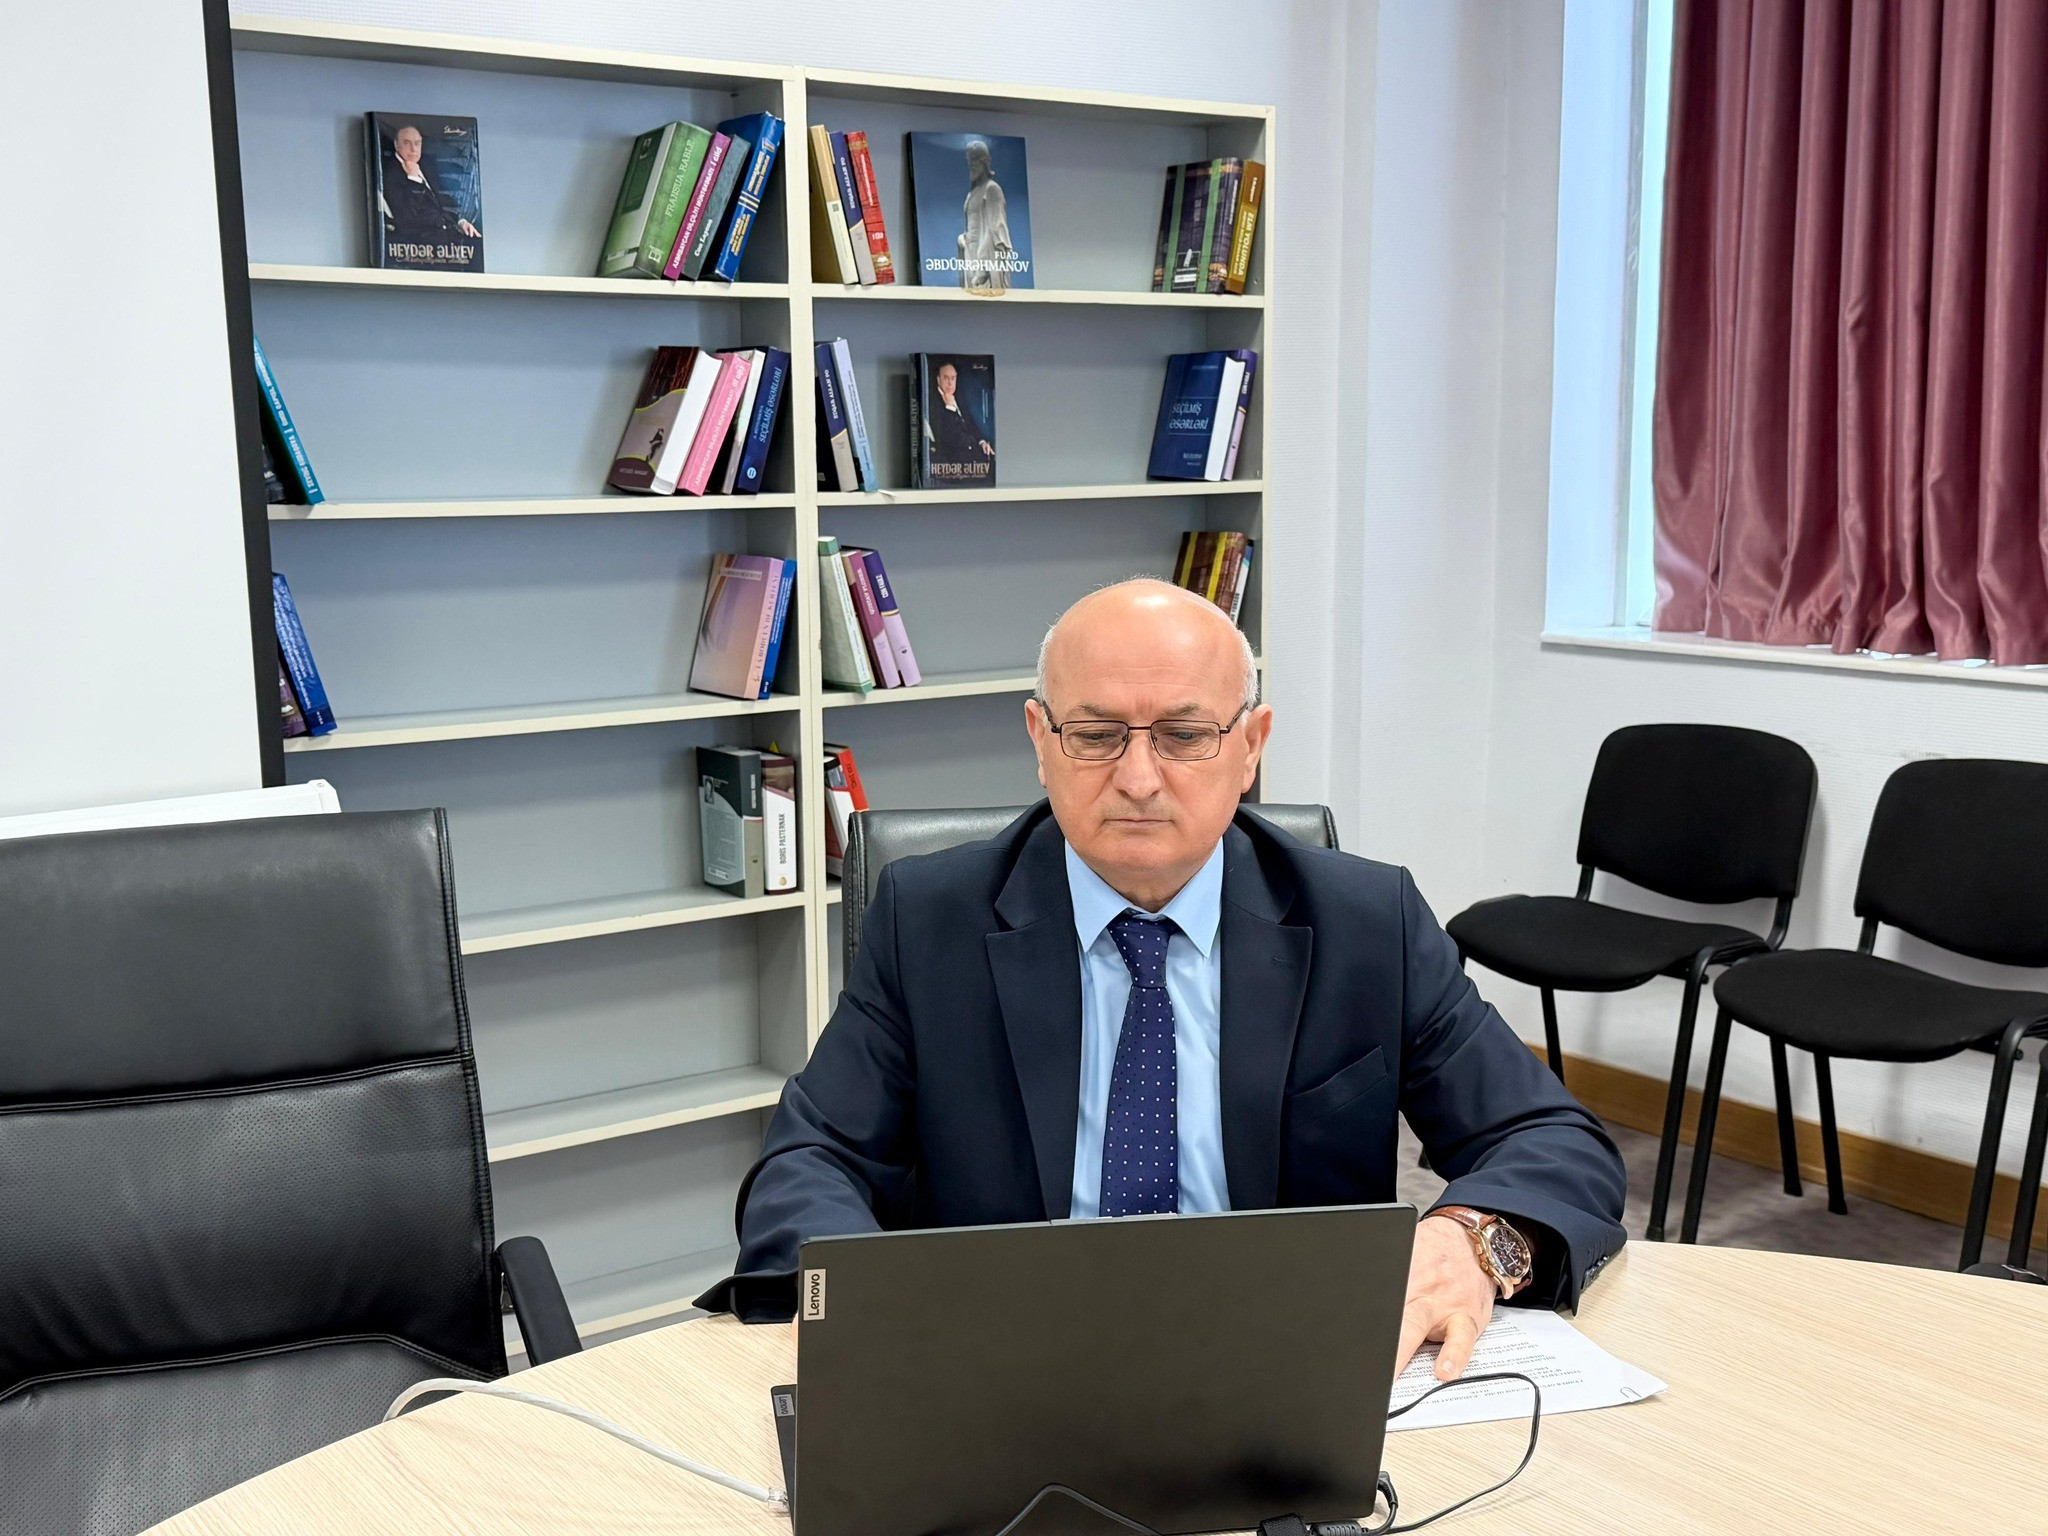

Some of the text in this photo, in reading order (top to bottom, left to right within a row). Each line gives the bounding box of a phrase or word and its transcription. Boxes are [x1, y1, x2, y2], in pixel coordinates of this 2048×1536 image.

[665, 139, 695, 217] FRANSUA RABLE
[388, 242, 434, 258] HEYDƏR
[436, 242, 475, 260] ƏLİYEV
[994, 250, 1019, 260] FUAD
[1238, 231, 1252, 275] YOLUNDA
[925, 257, 1030, 272] ƏBDÜRRƏHMANOV
[759, 366, 783, 444] SEÇİLMİŞ ƏSƏRLƏRİ
[931, 460, 990, 475] HEYDƏR ƏLİYEV
[778, 813, 786, 847] PASTERNAK
[808, 1273, 820, 1316] Lenovo
[778, 1396, 789, 1415] Lenovo
